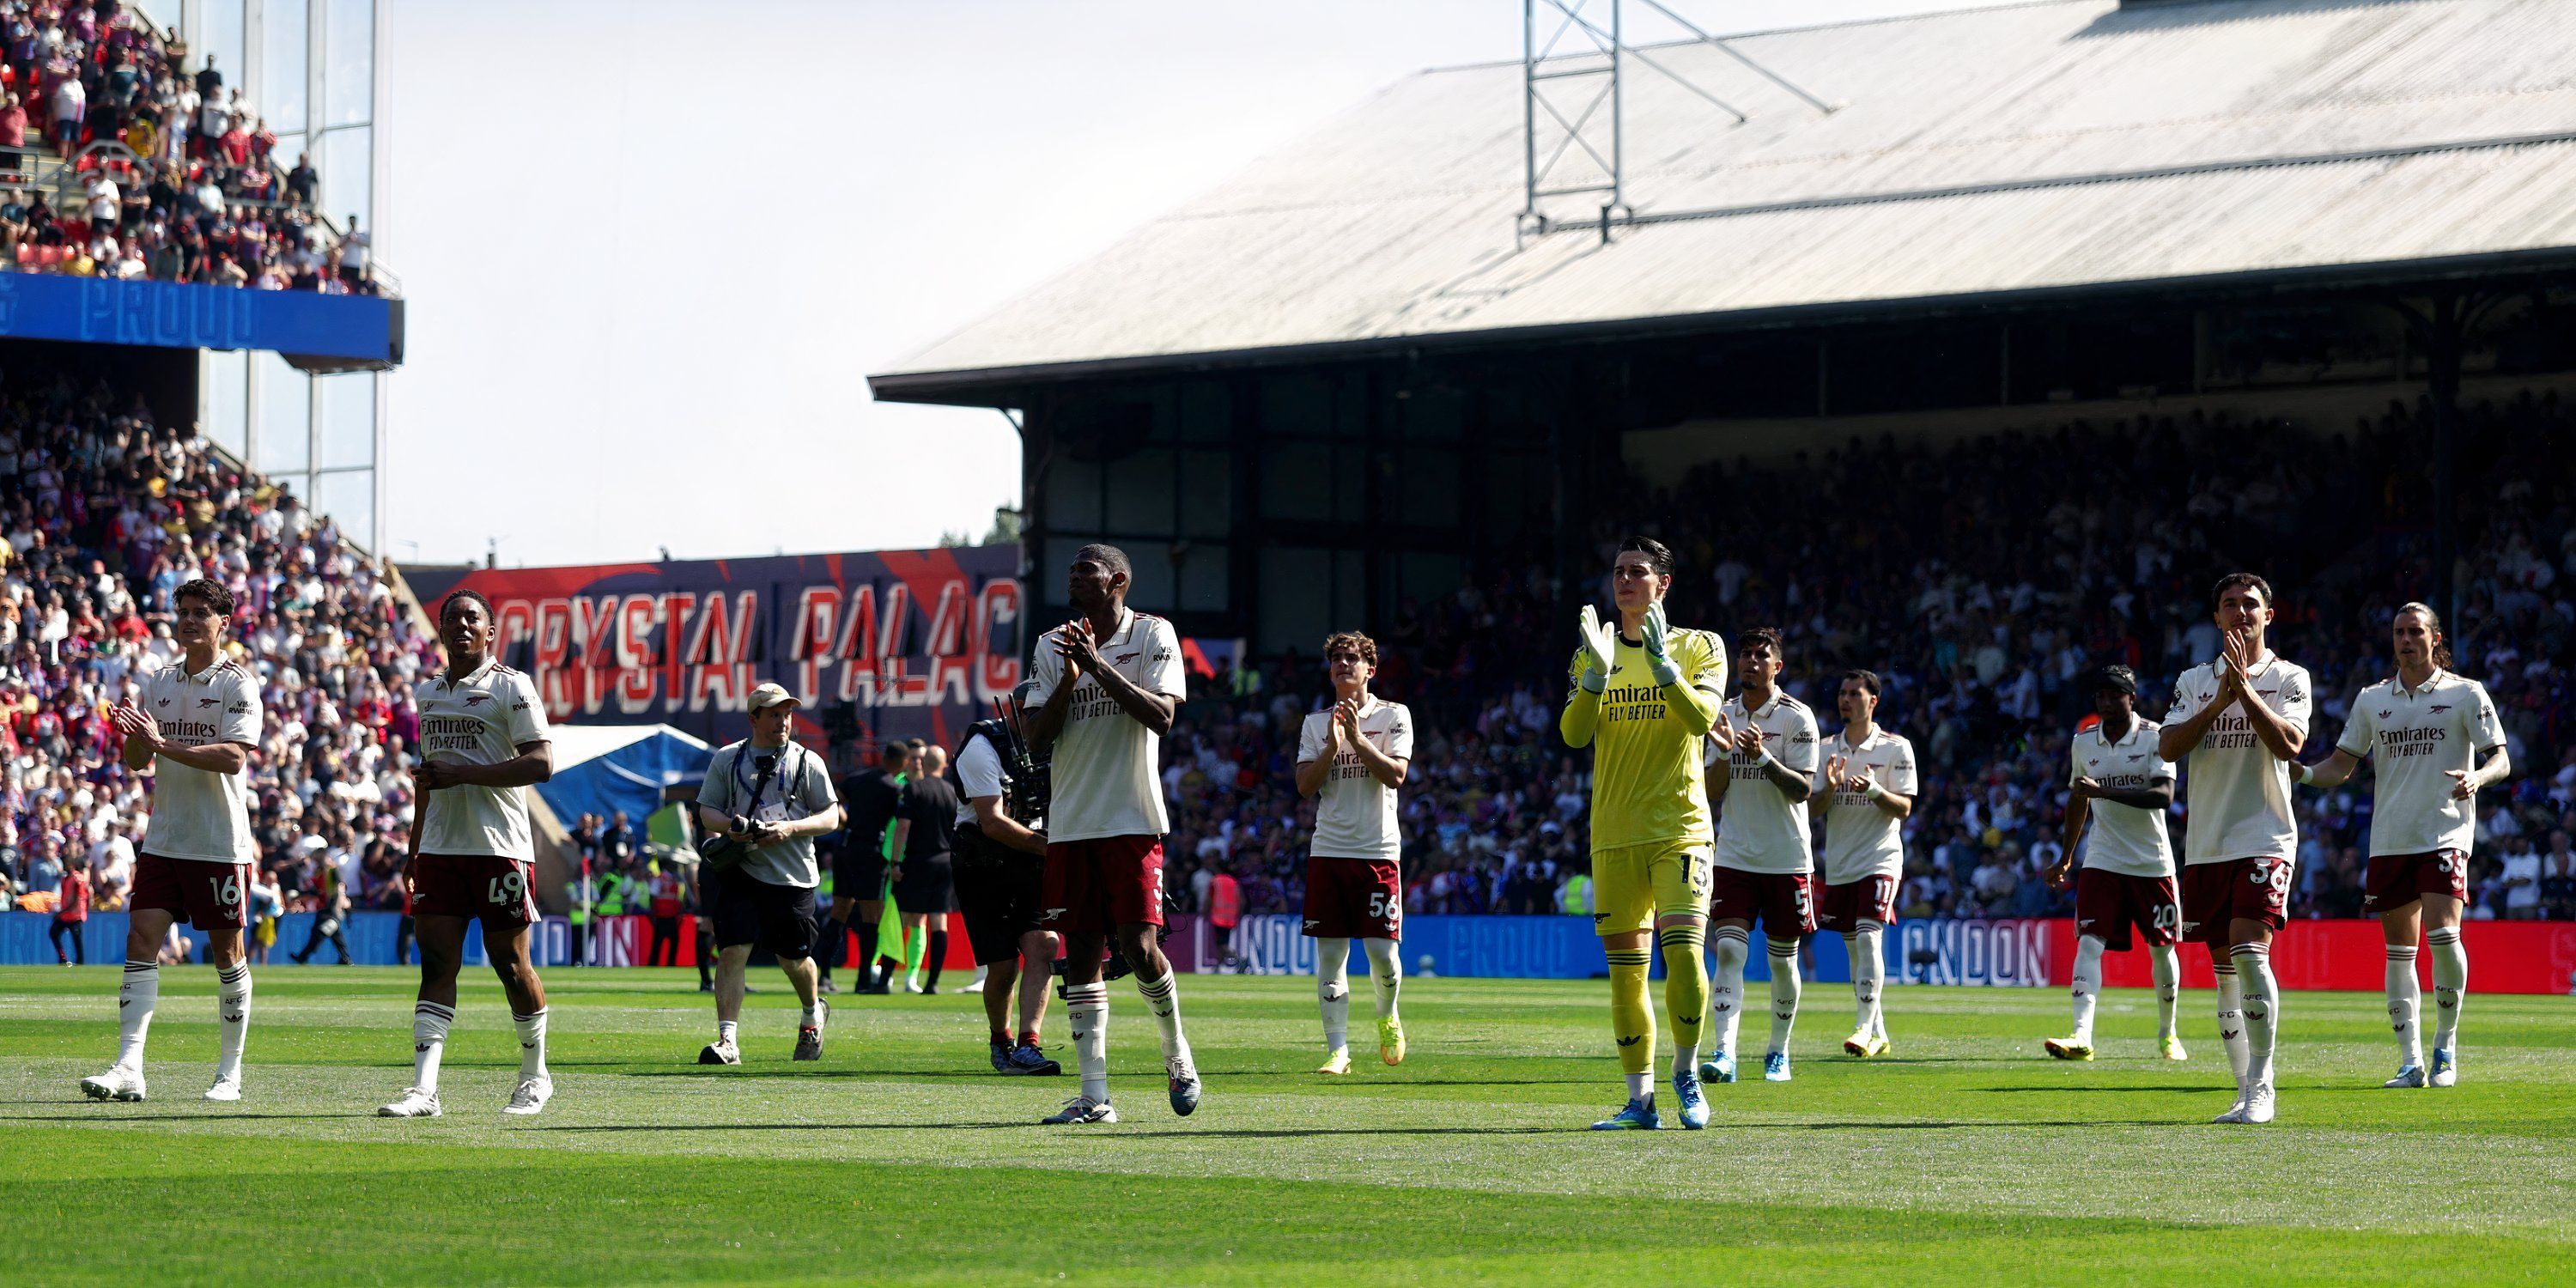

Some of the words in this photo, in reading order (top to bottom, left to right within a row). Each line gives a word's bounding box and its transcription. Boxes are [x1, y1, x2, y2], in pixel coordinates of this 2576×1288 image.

[80, 276, 257, 348] PROUD
[491, 591, 763, 718] CRYSTAL
[1072, 705, 1086, 721] FLY
[1609, 707, 1625, 721] FLY
[1628, 705, 1666, 720] BETTER
[421, 717, 485, 736] Emirates
[2379, 726, 2445, 744] Emirates
[2204, 734, 2217, 749] FLY
[2220, 733, 2257, 749] BETTER
[2389, 744, 2403, 757] FLY
[2403, 743, 2434, 756] BETTER
[2094, 774, 2145, 787] mirates
[1680, 854, 1707, 887] 13
[2250, 858, 2288, 892] 36
[210, 875, 240, 905] 16
[489, 872, 525, 906] 49
[1795, 888, 1810, 915] 5
[1874, 879, 1892, 903] 11
[1369, 892, 1399, 920] 56
[2153, 903, 2177, 929] 20
[1447, 917, 1567, 977] PROUD
[225, 996, 243, 1005] AFC
